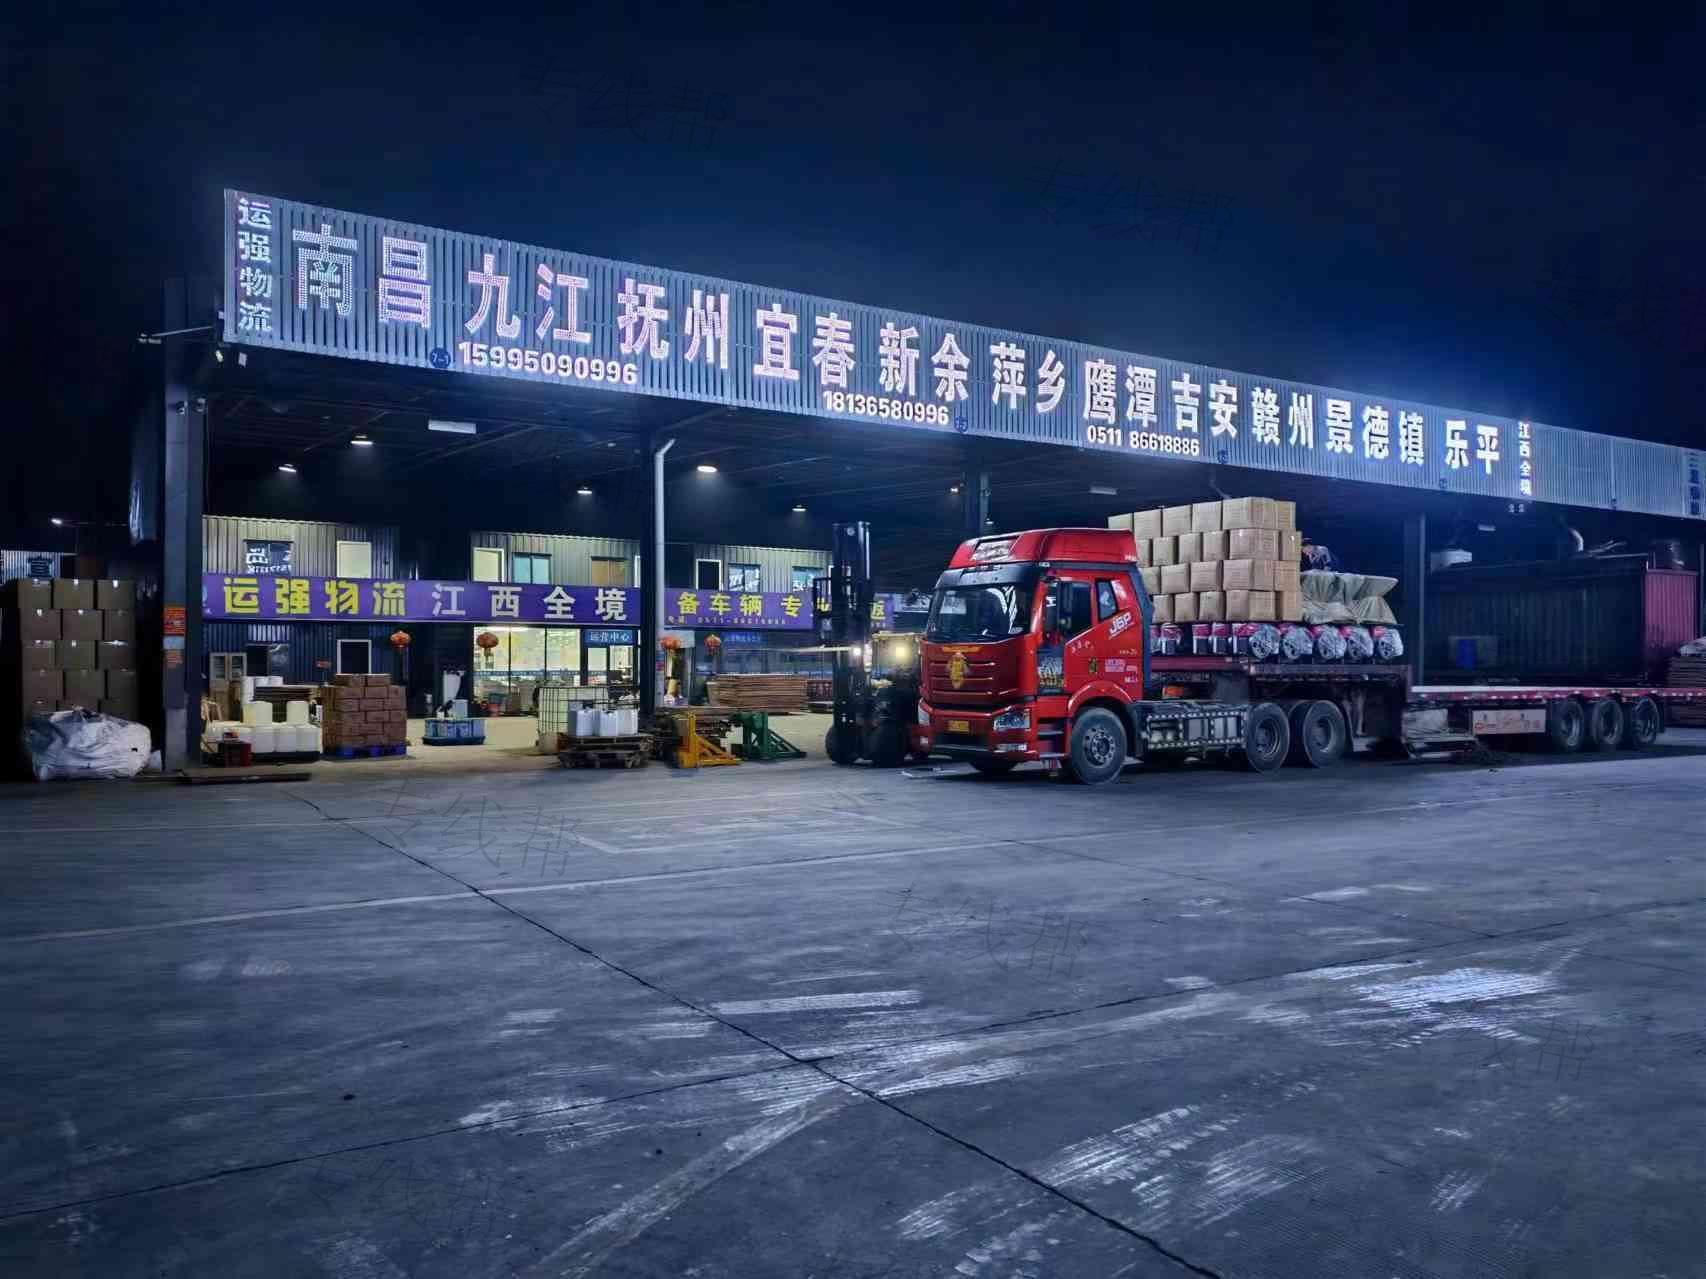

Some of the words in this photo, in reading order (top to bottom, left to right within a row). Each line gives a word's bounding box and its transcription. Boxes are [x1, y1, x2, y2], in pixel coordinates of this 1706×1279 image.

[238, 198, 272, 332] 运强物流
[293, 224, 431, 328] 南昌
[465, 253, 592, 344] 九江
[617, 278, 729, 369] 抚州
[753, 303, 856, 388] 宜春
[879, 322, 970, 401] 新余
[990, 342, 1065, 413] 萍乡
[1083, 358, 1157, 427] 鹰潭
[1171, 373, 1238, 438] 吉安
[1251, 386, 1313, 448] 赣州
[1326, 399, 1424, 467] 景德镇
[1445, 420, 1499, 475] 乐平
[458, 341, 639, 385] 15995090996
[822, 390, 949, 426] 18136580996
[1087, 425, 1122, 447] 0511
[1129, 430, 1200, 456] 86618886
[223, 577, 406, 617] 运强物流
[431, 582, 628, 621] 江西全境
[589, 631, 633, 643] 运营中心
